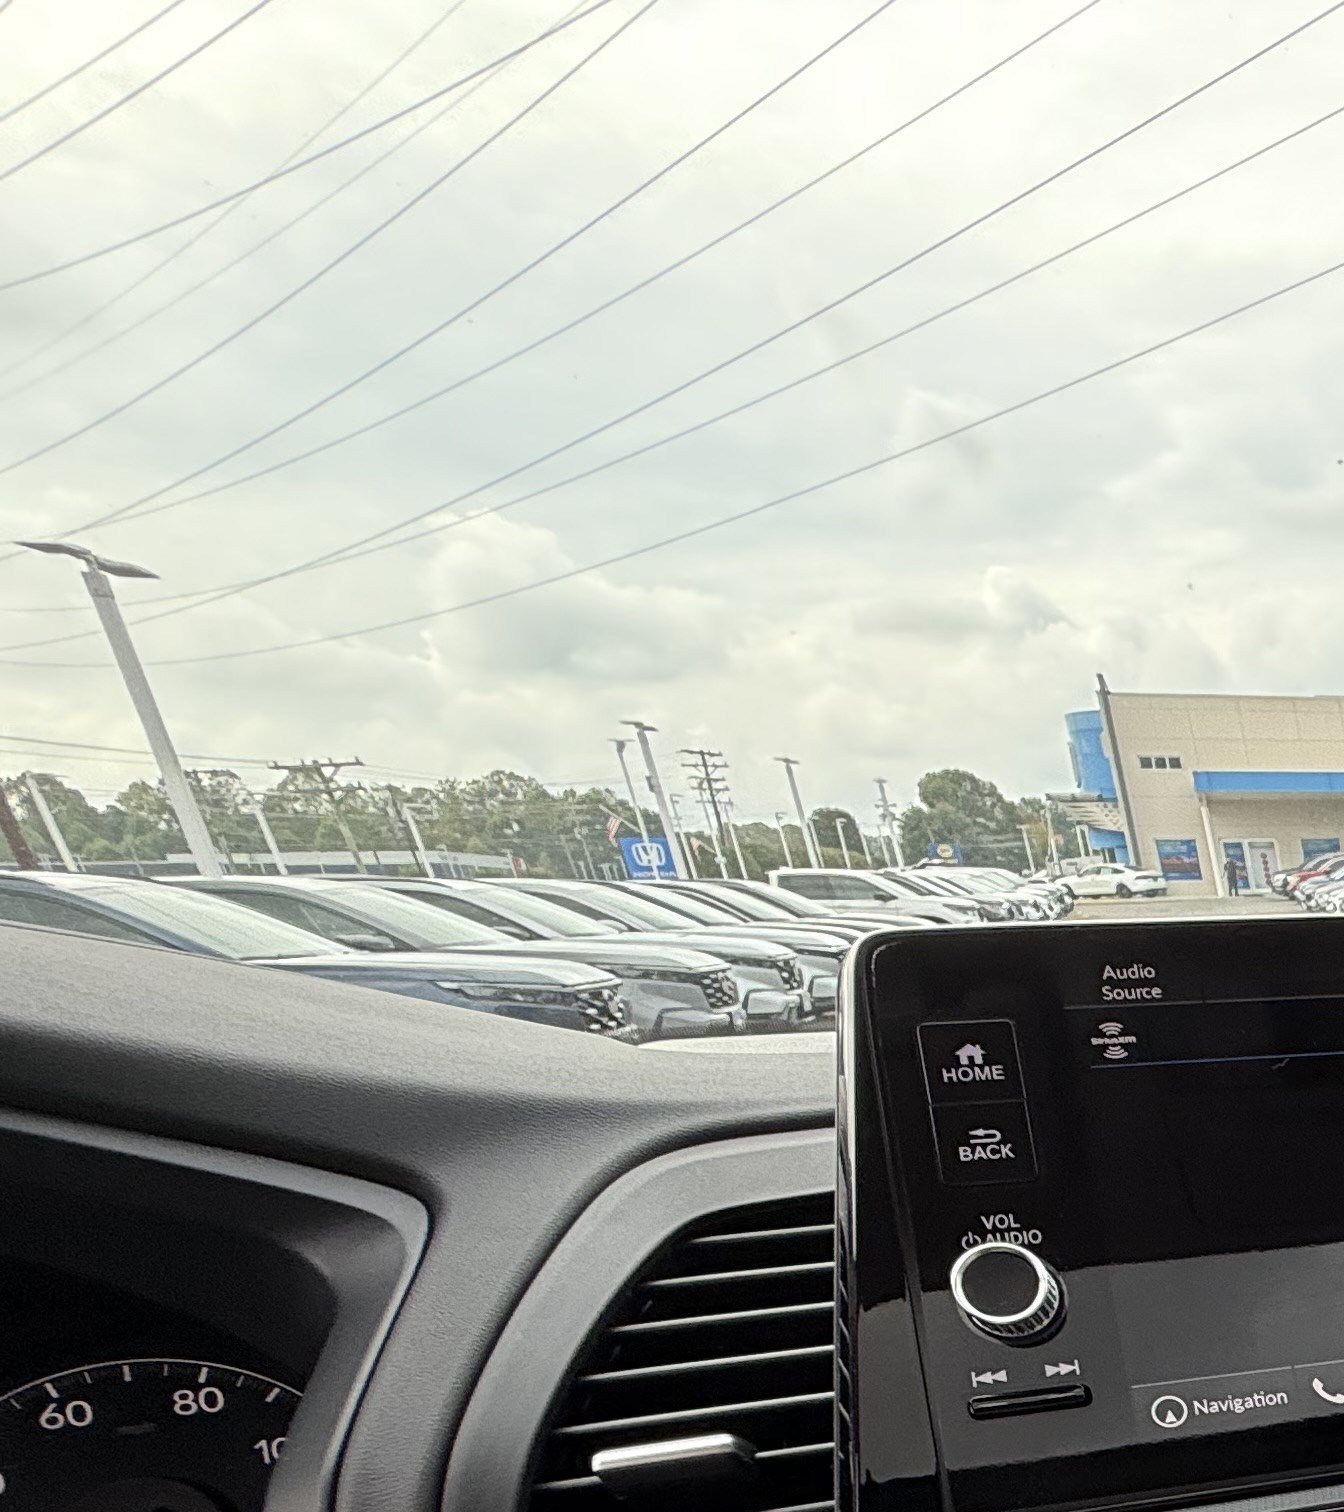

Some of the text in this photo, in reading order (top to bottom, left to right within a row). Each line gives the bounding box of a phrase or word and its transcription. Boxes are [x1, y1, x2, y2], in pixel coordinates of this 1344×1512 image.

[1103, 963, 1156, 981] Audio
[1101, 982, 1162, 1001] Source
[942, 1065, 1005, 1083] HOME
[958, 1143, 1015, 1162] BACK
[980, 1213, 1021, 1230] VOL
[986, 1229, 1042, 1245] AUDIO
[173, 1386, 225, 1416] 80
[1193, 1387, 1288, 1415] Navigation
[38, 1401, 93, 1430] 60
